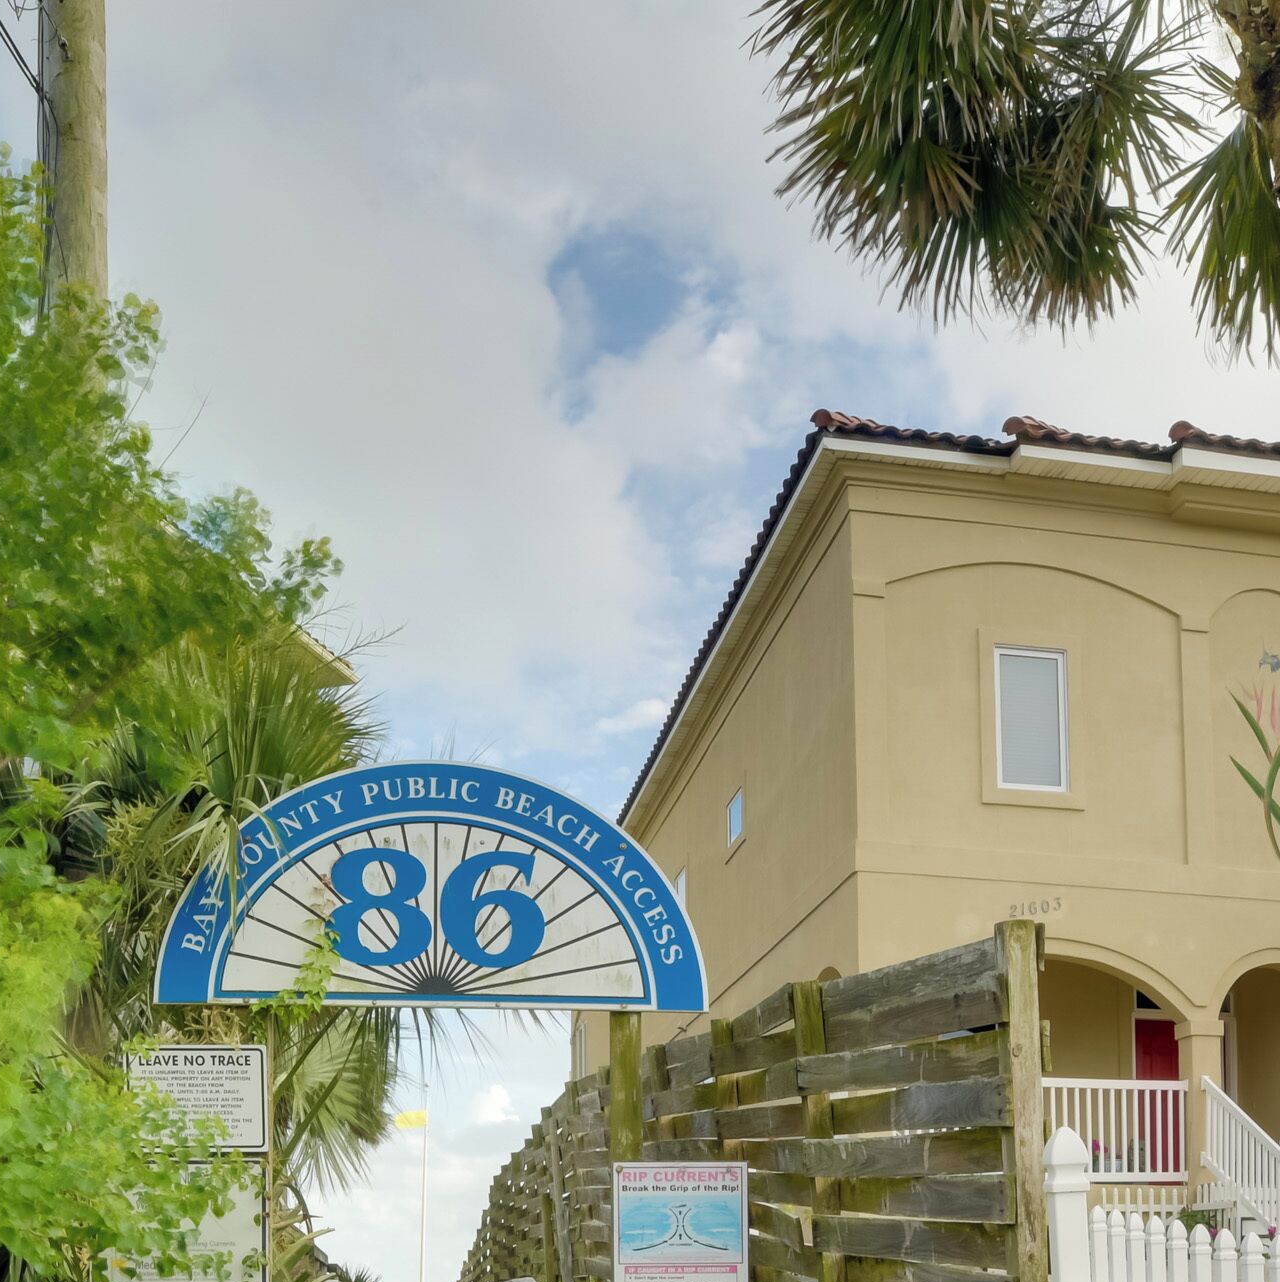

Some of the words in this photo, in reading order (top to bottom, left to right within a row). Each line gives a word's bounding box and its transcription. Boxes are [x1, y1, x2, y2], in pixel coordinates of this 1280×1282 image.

[360, 776, 480, 807] PUBLIC
[494, 786, 601, 853] BEACH
[601, 855, 683, 965] ACCESS
[325, 847, 545, 968] 86
[138, 1055, 178, 1066] LEAVE
[184, 1055, 205, 1066] NO
[210, 1055, 251, 1066] TRACE
[622, 1171, 648, 1182] RIP
[653, 1171, 739, 1182] CURRENTS
[622, 1184, 649, 1192] Break
[652, 1184, 667, 1192] the
[670, 1184, 688, 1193] Grip
[721, 1184, 739, 1192] Rip!
